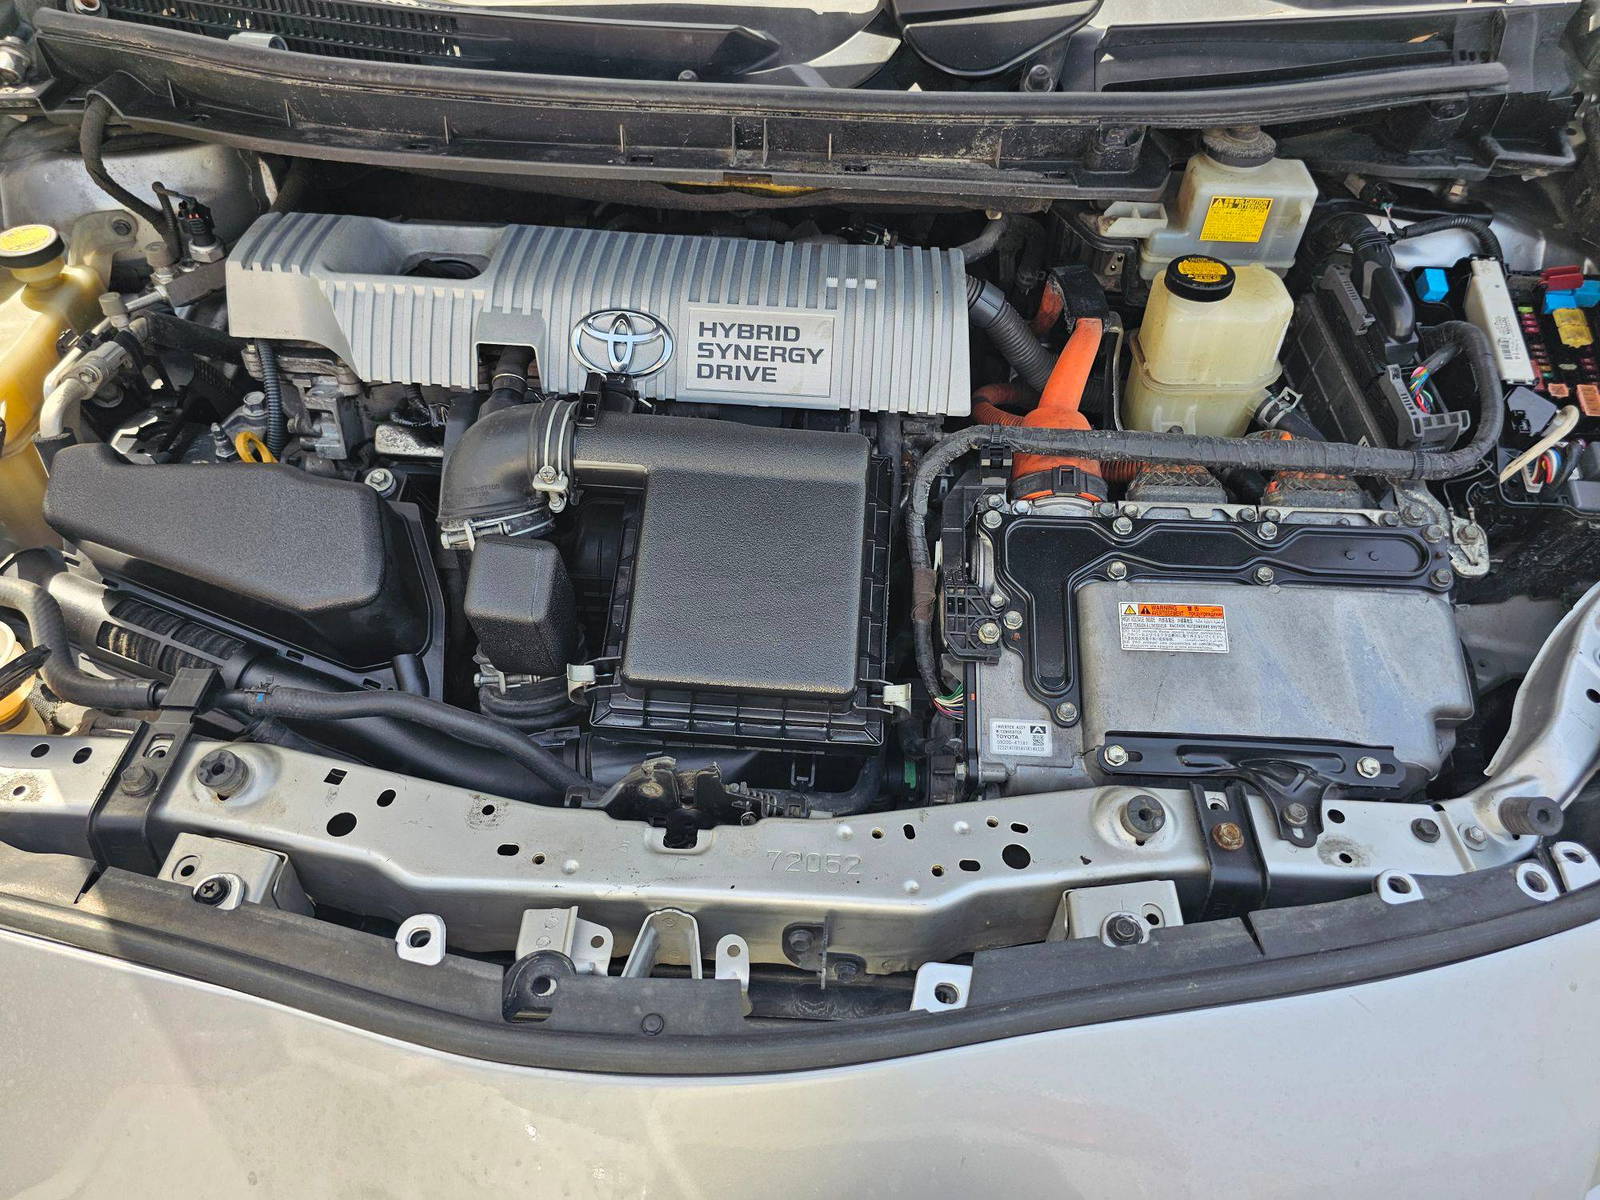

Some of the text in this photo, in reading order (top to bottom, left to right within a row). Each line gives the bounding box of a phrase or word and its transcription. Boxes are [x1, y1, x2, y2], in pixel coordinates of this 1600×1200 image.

[698, 321, 800, 342] HYBRID
[697, 342, 824, 364] SYNERGY
[696, 363, 777, 383] DRIVE
[767, 850, 863, 875] 72052
